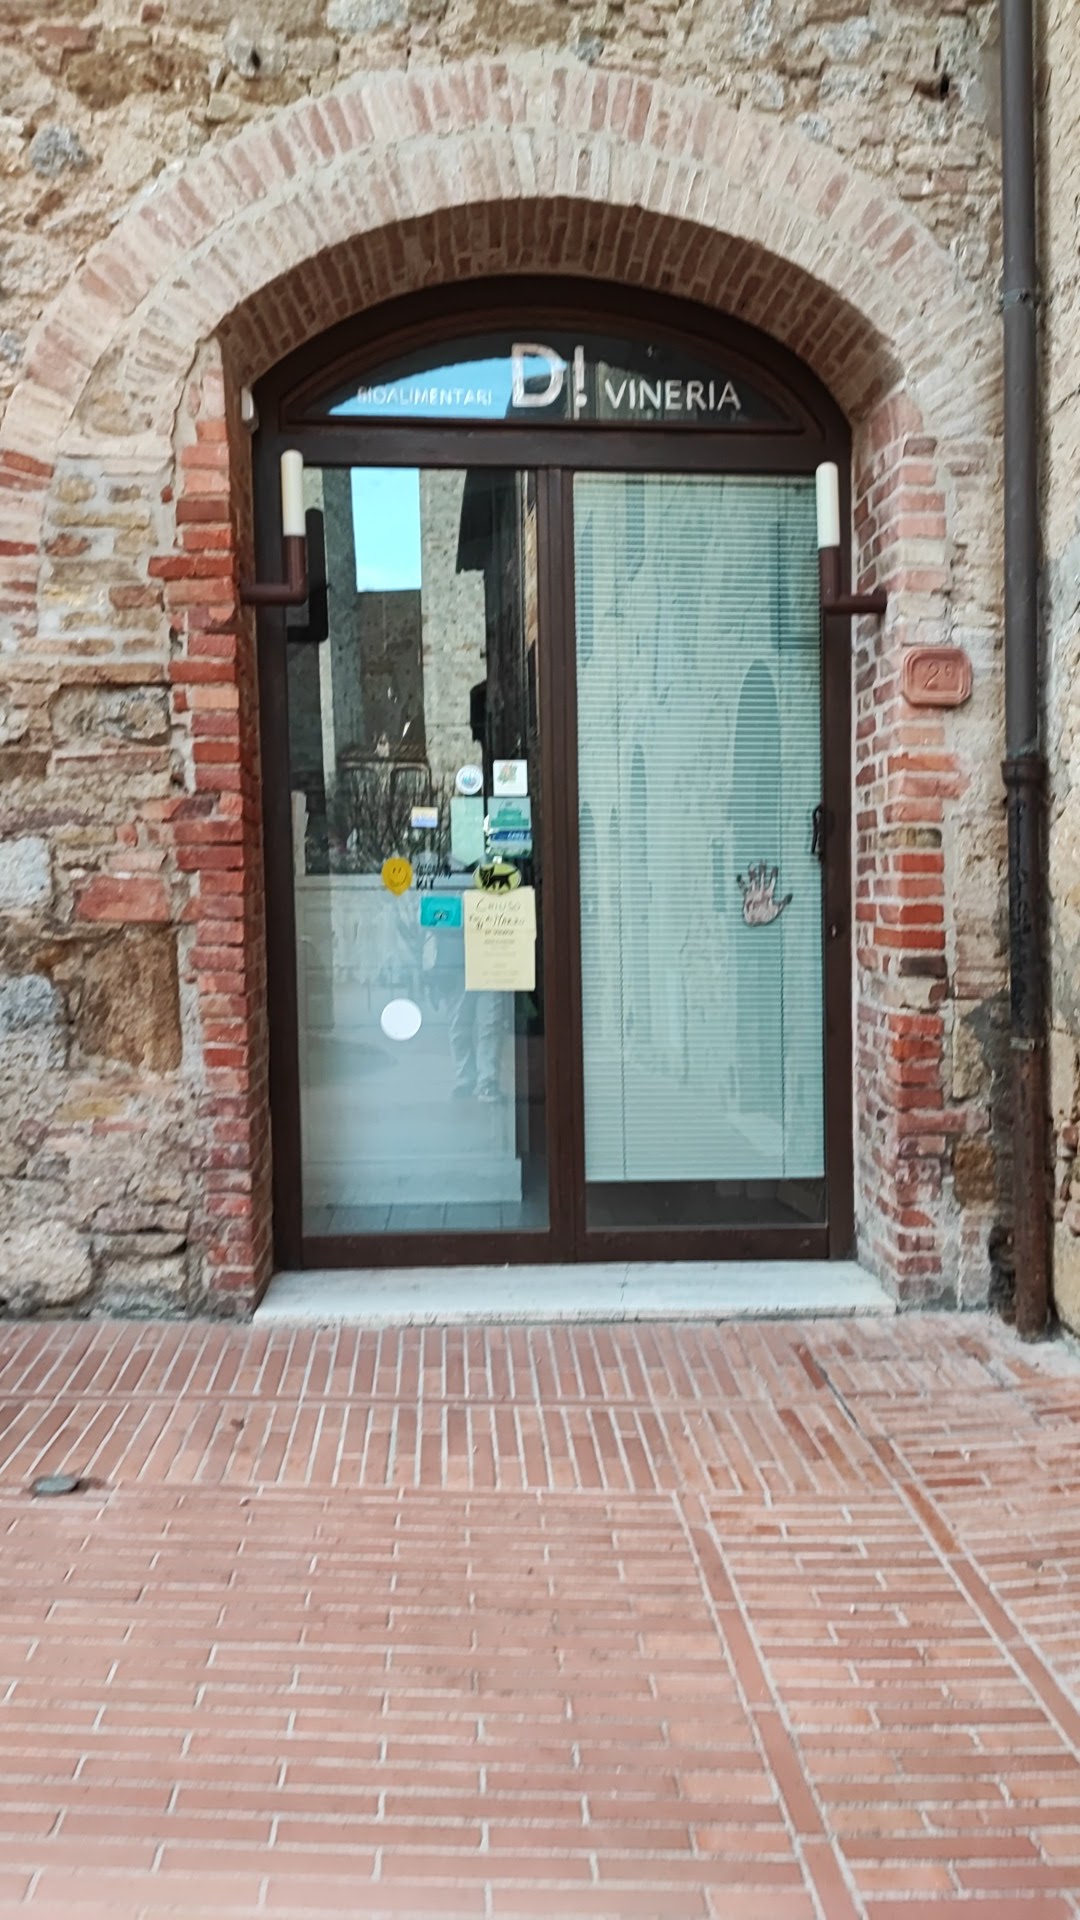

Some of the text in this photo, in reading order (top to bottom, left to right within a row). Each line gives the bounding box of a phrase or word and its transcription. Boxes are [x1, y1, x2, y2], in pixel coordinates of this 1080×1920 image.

[357, 343, 742, 410] BIOALIMENTARI D! VINERIA
